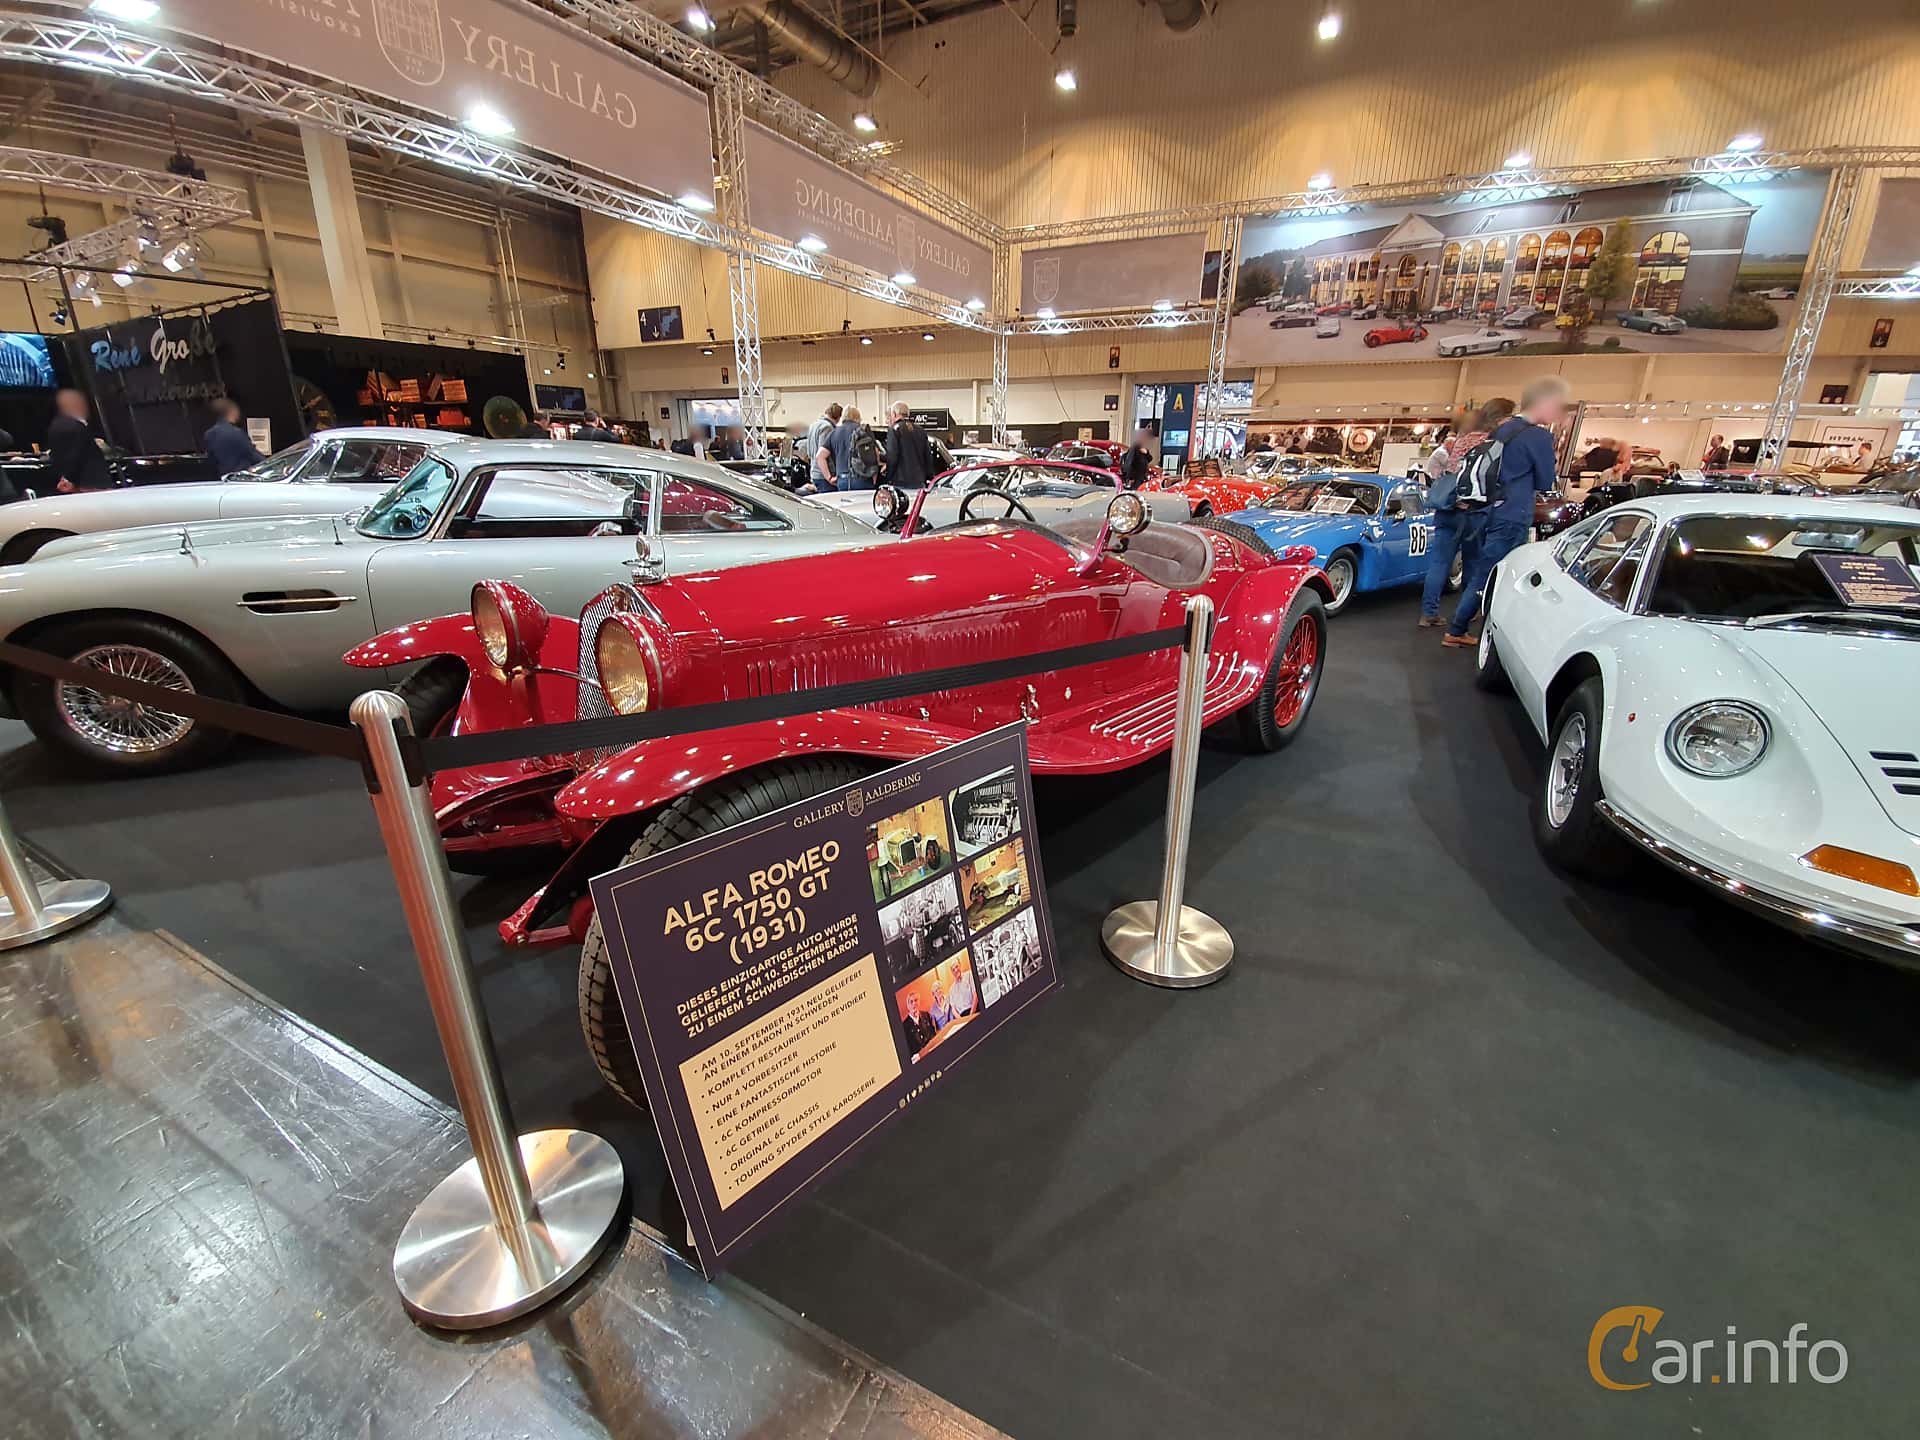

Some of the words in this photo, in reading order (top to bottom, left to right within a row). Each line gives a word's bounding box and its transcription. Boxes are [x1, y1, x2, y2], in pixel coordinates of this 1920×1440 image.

[640, 312, 647, 326] 4
[1173, 393, 1184, 411] A
[1411, 526, 1426, 554] 86
[793, 800, 845, 828] GALLERY
[865, 772, 921, 801] AALDERING
[664, 882, 743, 935] ALFA
[749, 840, 840, 895] ROMEO
[685, 917, 725, 952] 6C
[732, 887, 791, 929] 1750
[799, 867, 830, 898] GT
[676, 986, 718, 1015] DIESES
[720, 946, 794, 990] EINZIGARTIGE
[796, 932, 823, 953] AUTO
[824, 914, 858, 938] WURDE
[681, 989, 741, 1027] GELIEFERT
[744, 978, 762, 994] AM
[764, 969, 780, 981] 10.
[781, 937, 837, 973] SEPTEMBER
[838, 926, 858, 942] 1931
[729, 907, 806, 965] (1931)
[687, 1021, 705, 1038] ZU
[707, 1000, 744, 1028] EINEM
[747, 955, 825, 1006] SCHWEDISCHEN
[826, 936, 859, 960] BARON
[700, 1057, 717, 1071] AM
[719, 1049, 734, 1062] 10.
[734, 1016, 785, 1050] SEPTEMBER
[787, 1005, 805, 1020] 1931
[806, 993, 824, 1008] NEU
[825, 969, 863, 997] GELIEFERT
[703, 1068, 718, 1081] AN
[720, 1050, 750, 1071] EINEM
[751, 1028, 783, 1051] BARON
[784, 1022, 794, 1032] IN
[795, 993, 839, 1025] SCHWEDEN
[708, 1061, 758, 1096] KOMPLETT
[758, 1027, 811, 1065] RESTAURIERT
[812, 1016, 830, 1030] UND
[831, 991, 867, 1018] REVIDIERT
[712, 1094, 733, 1112] NUR
[734, 1088, 740, 1097] 4
[742, 1050, 799, 1091] VORBESITZER
[716, 1107, 738, 1127] EINE
[740, 1066, 801, 1111] FANTASTISCHE
[801, 1041, 837, 1070] HISTORIE
[721, 1129, 734, 1142] 6C
[735, 1068, 823, 1132] KOMPRESSORMOTOR
[725, 1144, 738, 1157] 6C
[739, 1113, 781, 1146] GETRIEBE
[730, 1137, 773, 1172] ORIGINAL
[774, 1127, 786, 1139] 6C
[787, 1102, 820, 1130] CHASSIS
[734, 1154, 775, 1187] TOURING
[776, 1128, 807, 1156] SPYDER
[808, 1110, 832, 1131] STYLE
[832, 1076, 876, 1113] KAROSSERIE
